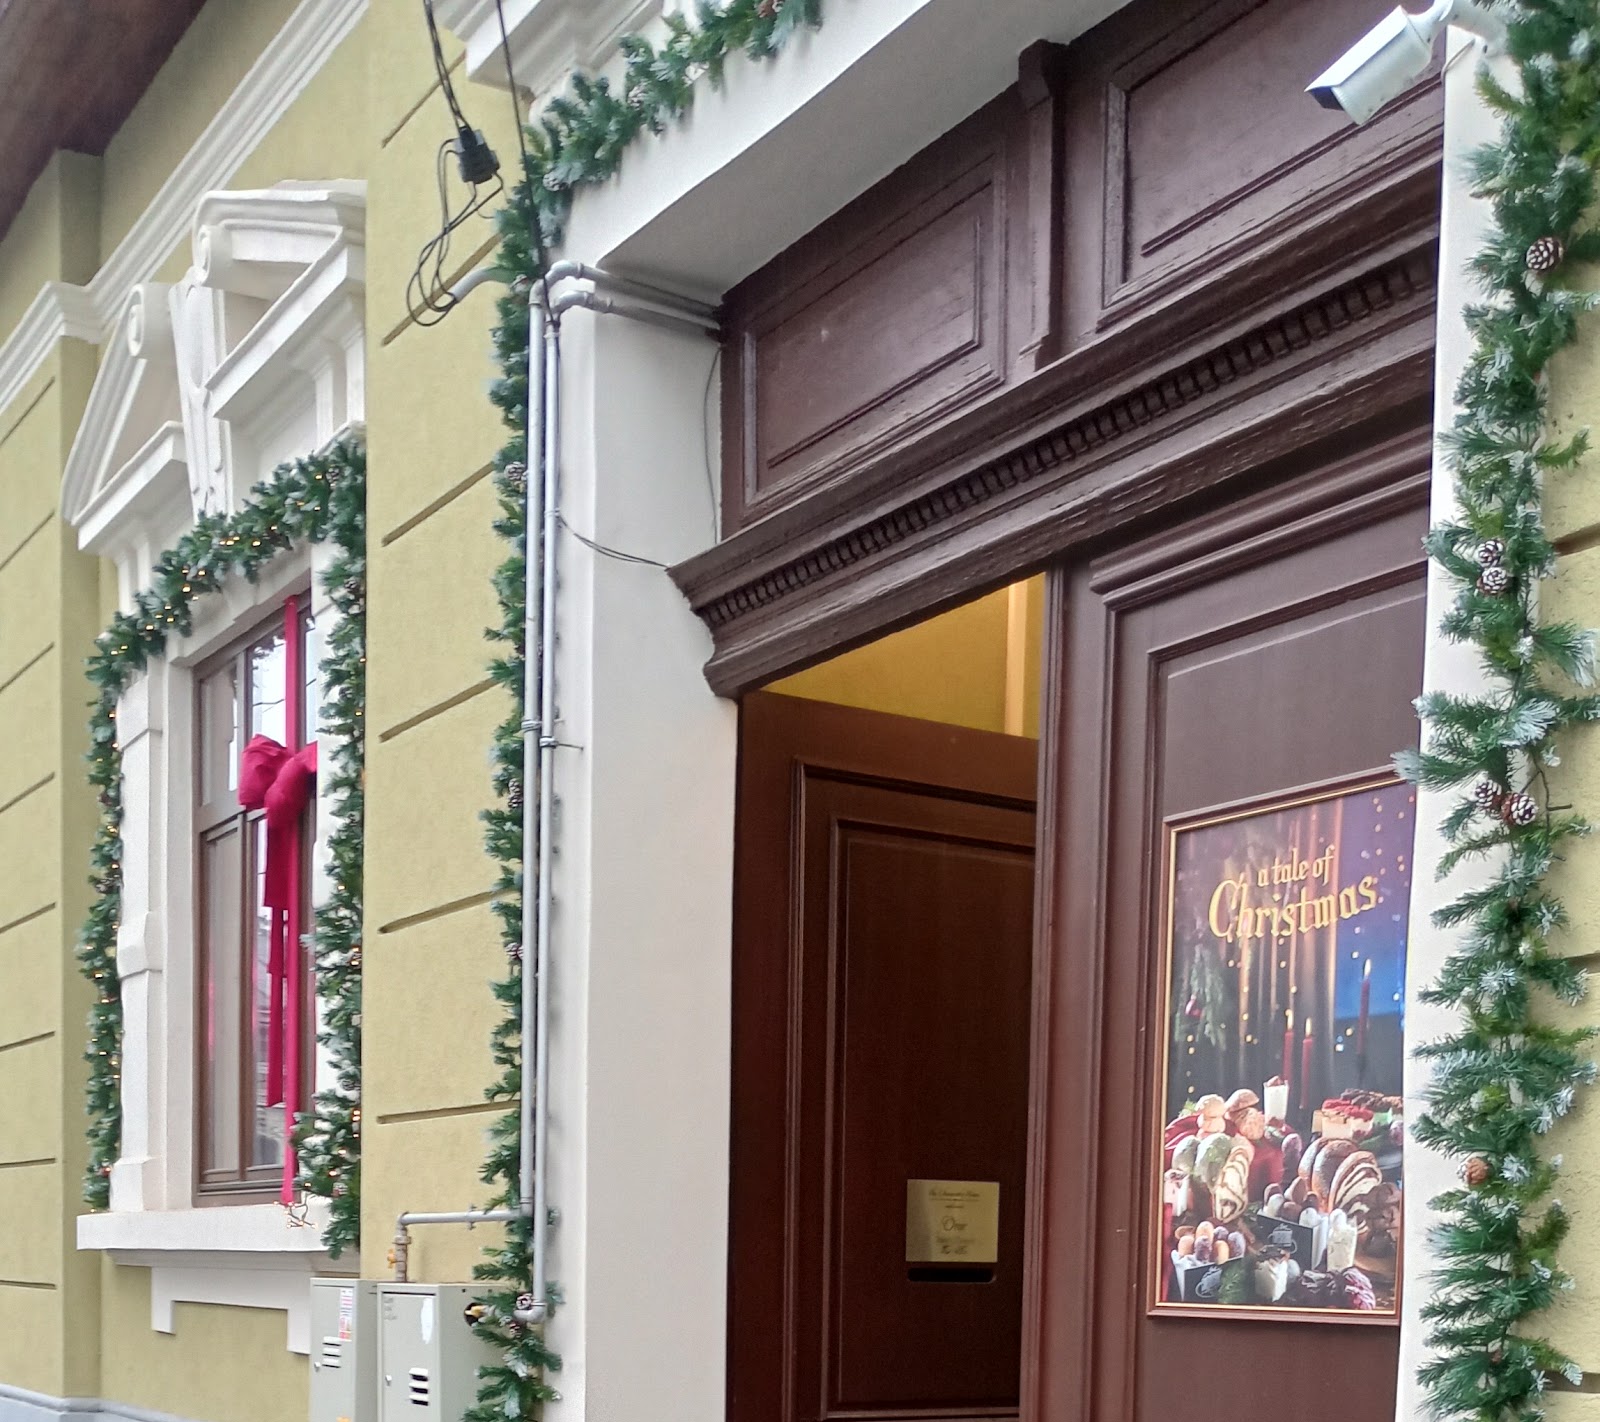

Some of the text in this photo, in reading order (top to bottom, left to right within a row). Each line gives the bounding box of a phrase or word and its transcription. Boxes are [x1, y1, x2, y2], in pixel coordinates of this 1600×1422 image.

[1257, 844, 1336, 888] a tale of
[1208, 872, 1378, 944] Christmas
